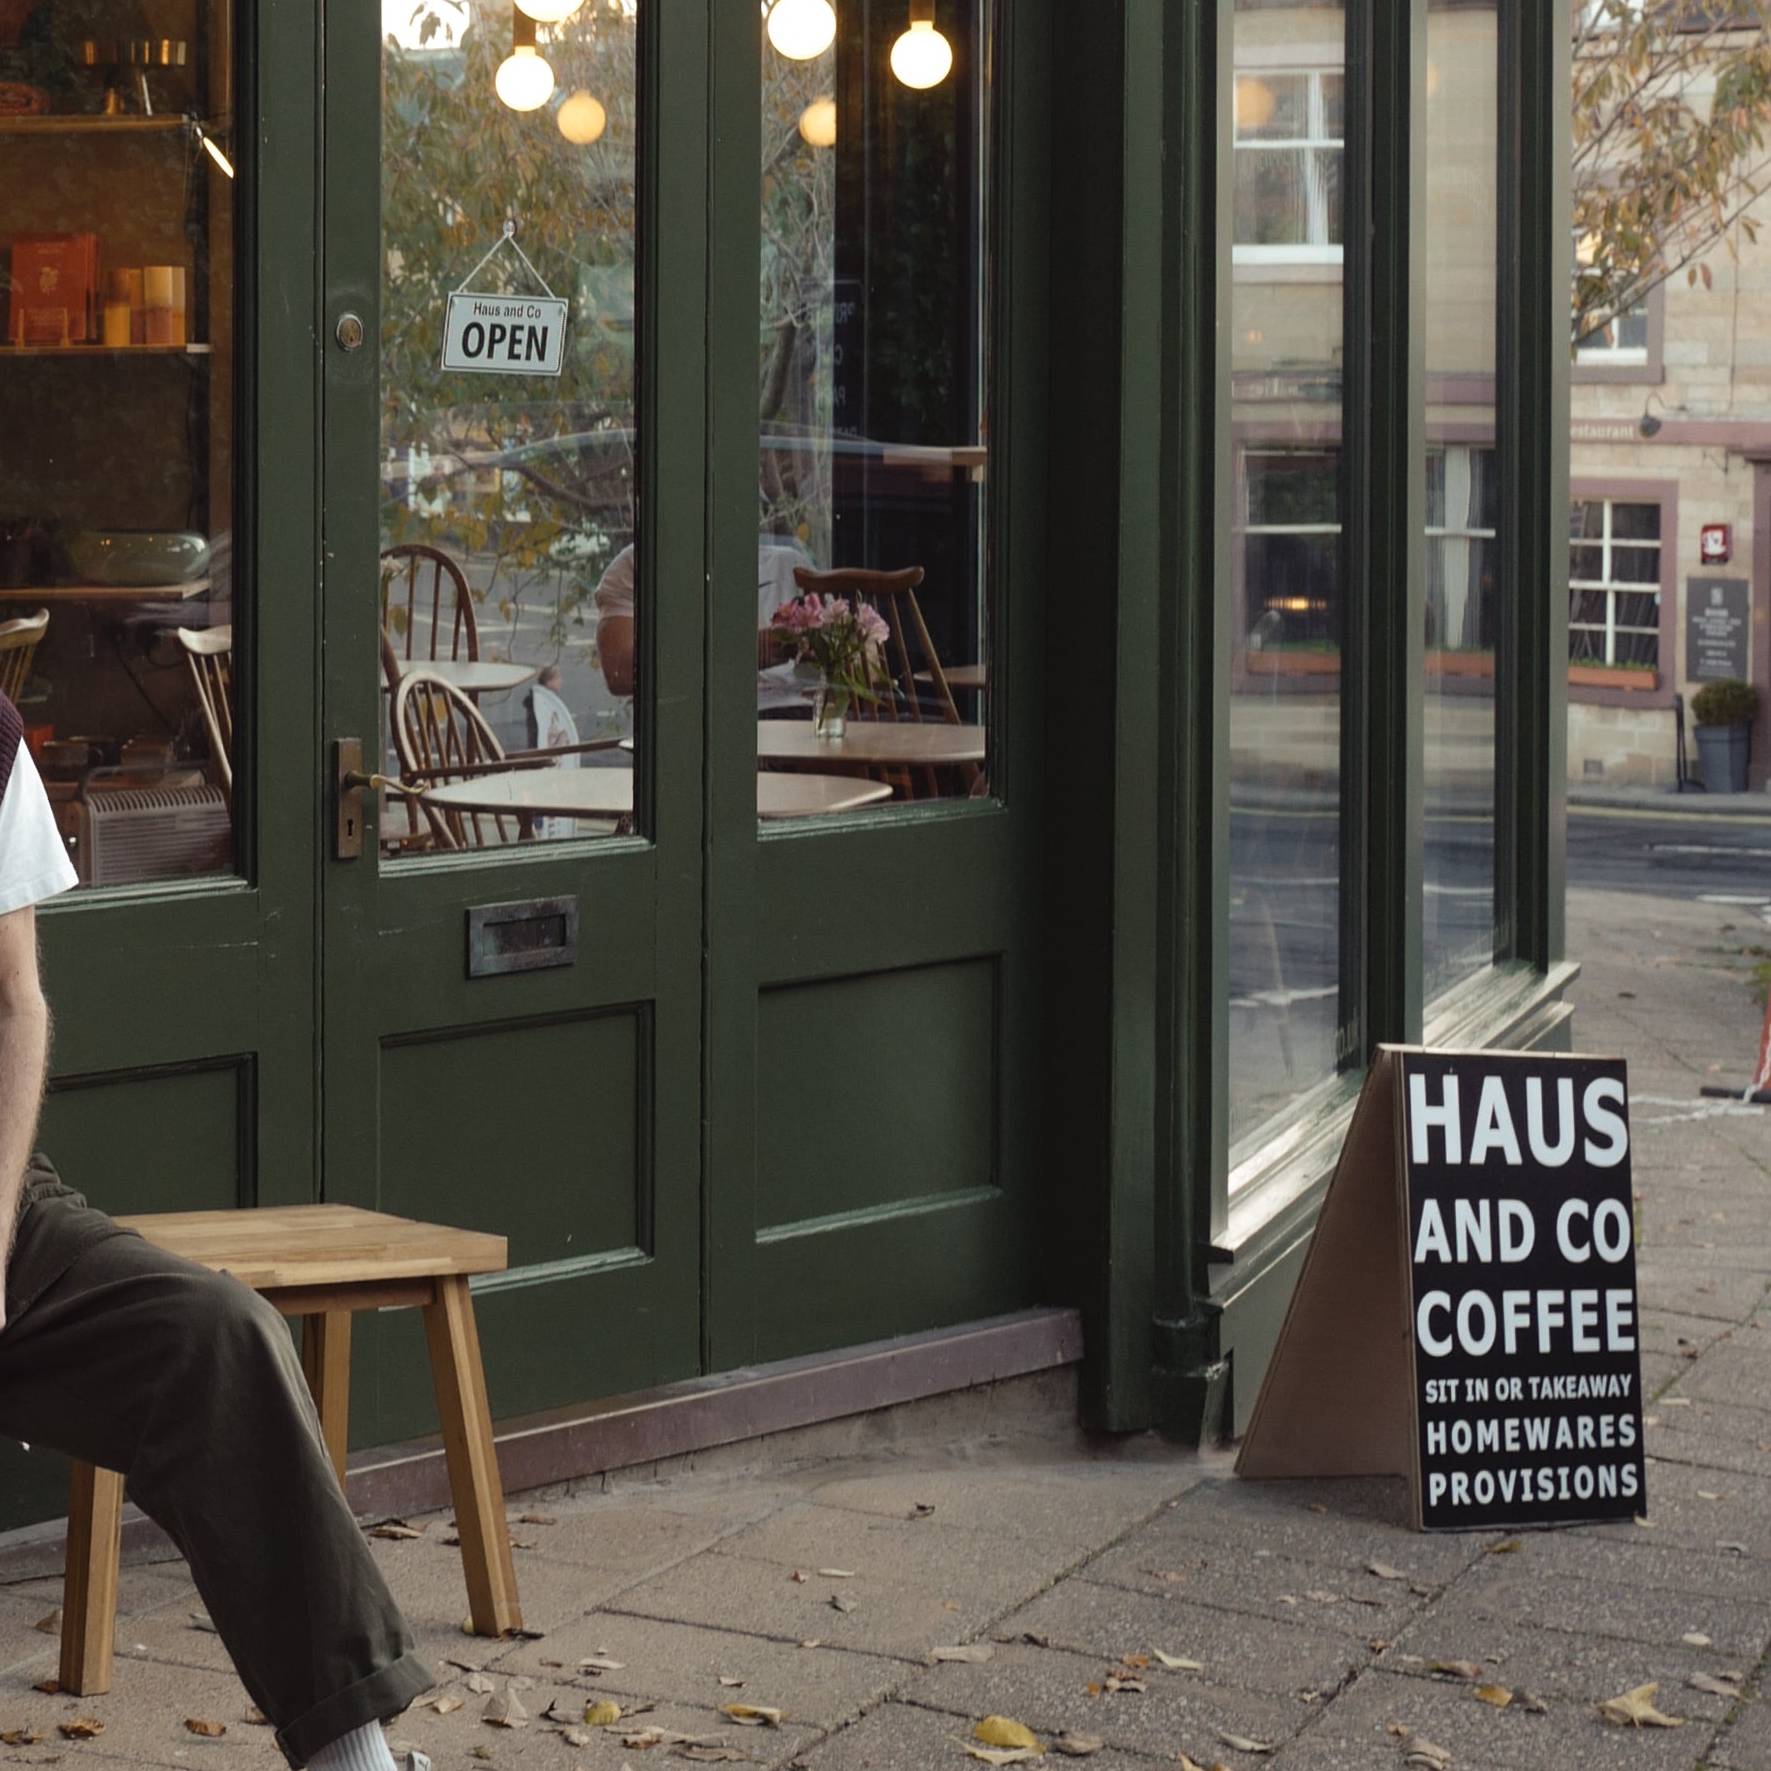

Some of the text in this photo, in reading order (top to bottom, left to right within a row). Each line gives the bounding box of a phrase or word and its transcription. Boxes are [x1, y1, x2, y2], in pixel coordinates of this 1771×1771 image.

[473, 302, 541, 318] Haus and Co
[461, 321, 549, 362] OPEN
[1570, 423, 1634, 439] estaurant
[1408, 1073, 1628, 1168] HAUS
[1414, 1198, 1631, 1264] AND CO
[1416, 1289, 1636, 1357] COFFEE
[1425, 1373, 1633, 1404] SIT IN OR TAKEAWAY
[1426, 1414, 1637, 1456] HOMEWARES
[1429, 1463, 1639, 1507] PROVISIONS
